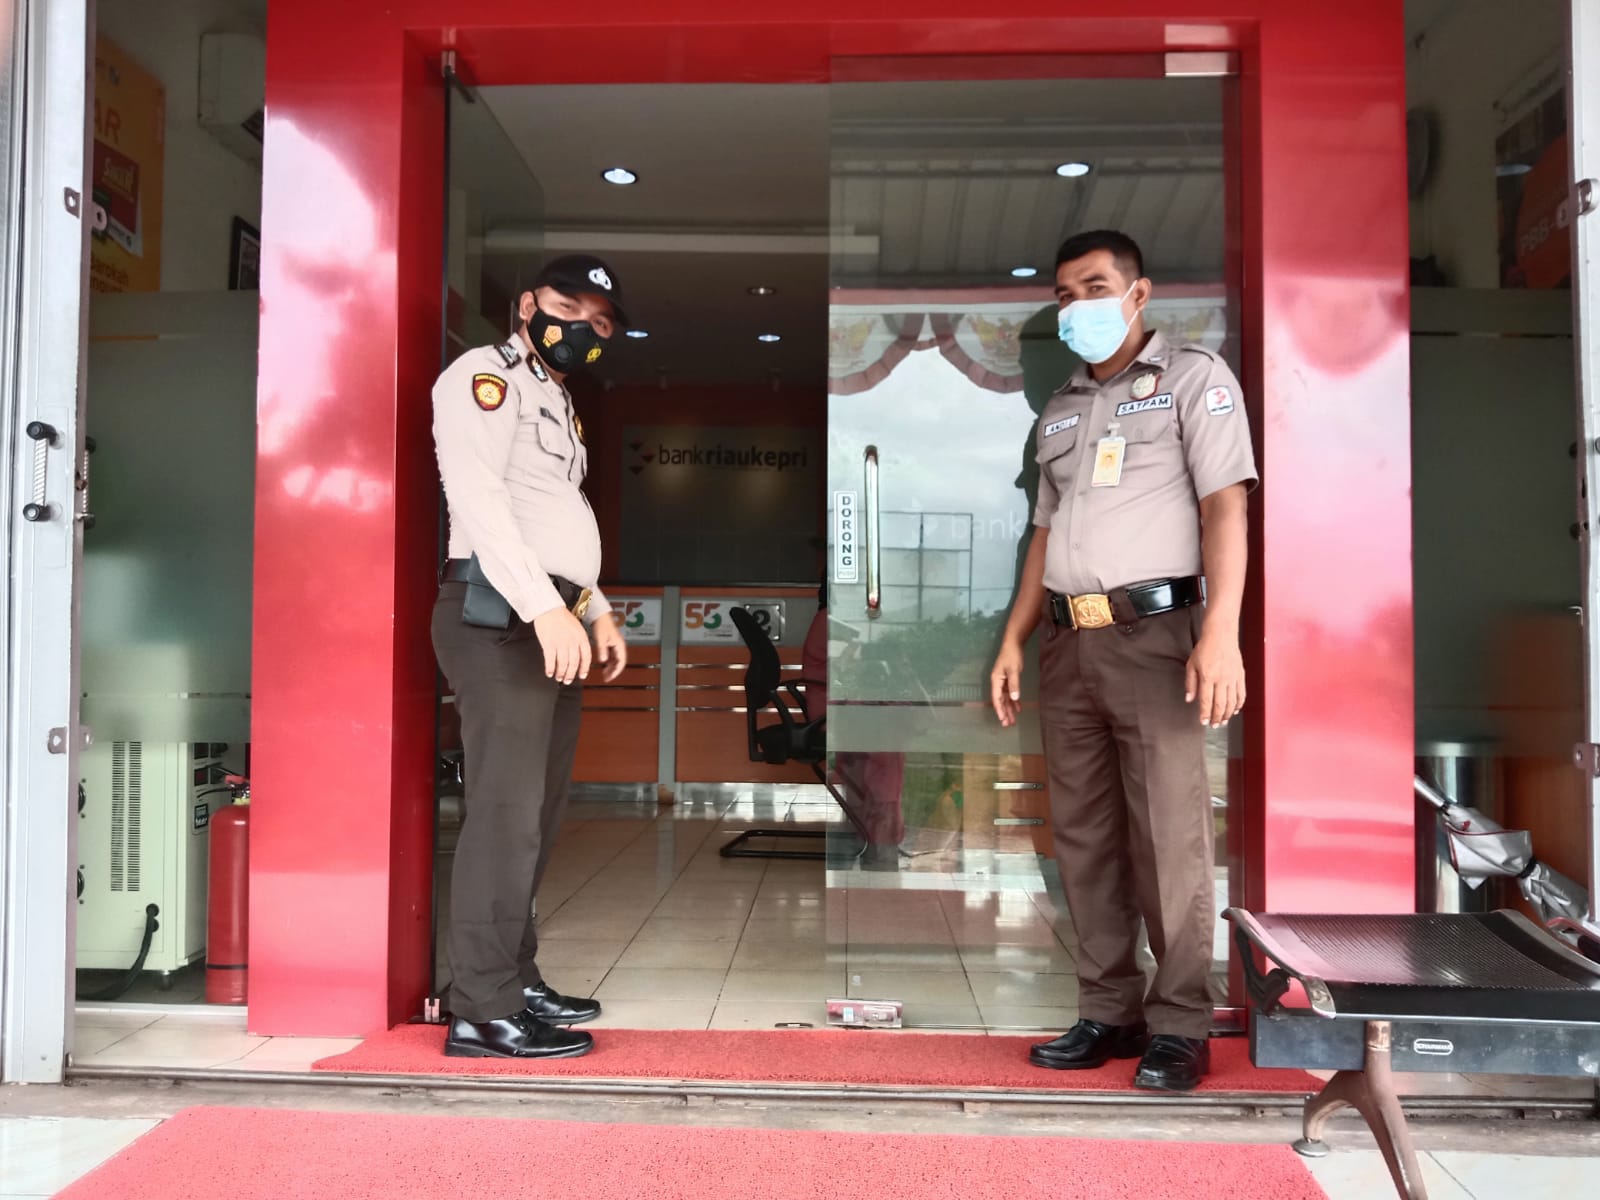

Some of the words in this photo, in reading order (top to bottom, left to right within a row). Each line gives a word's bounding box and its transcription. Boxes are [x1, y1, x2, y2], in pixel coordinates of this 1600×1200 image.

[1121, 397, 1169, 412] SATPAM
[659, 444, 808, 472] bankriaukepri
[841, 495, 853, 567] DORONG
